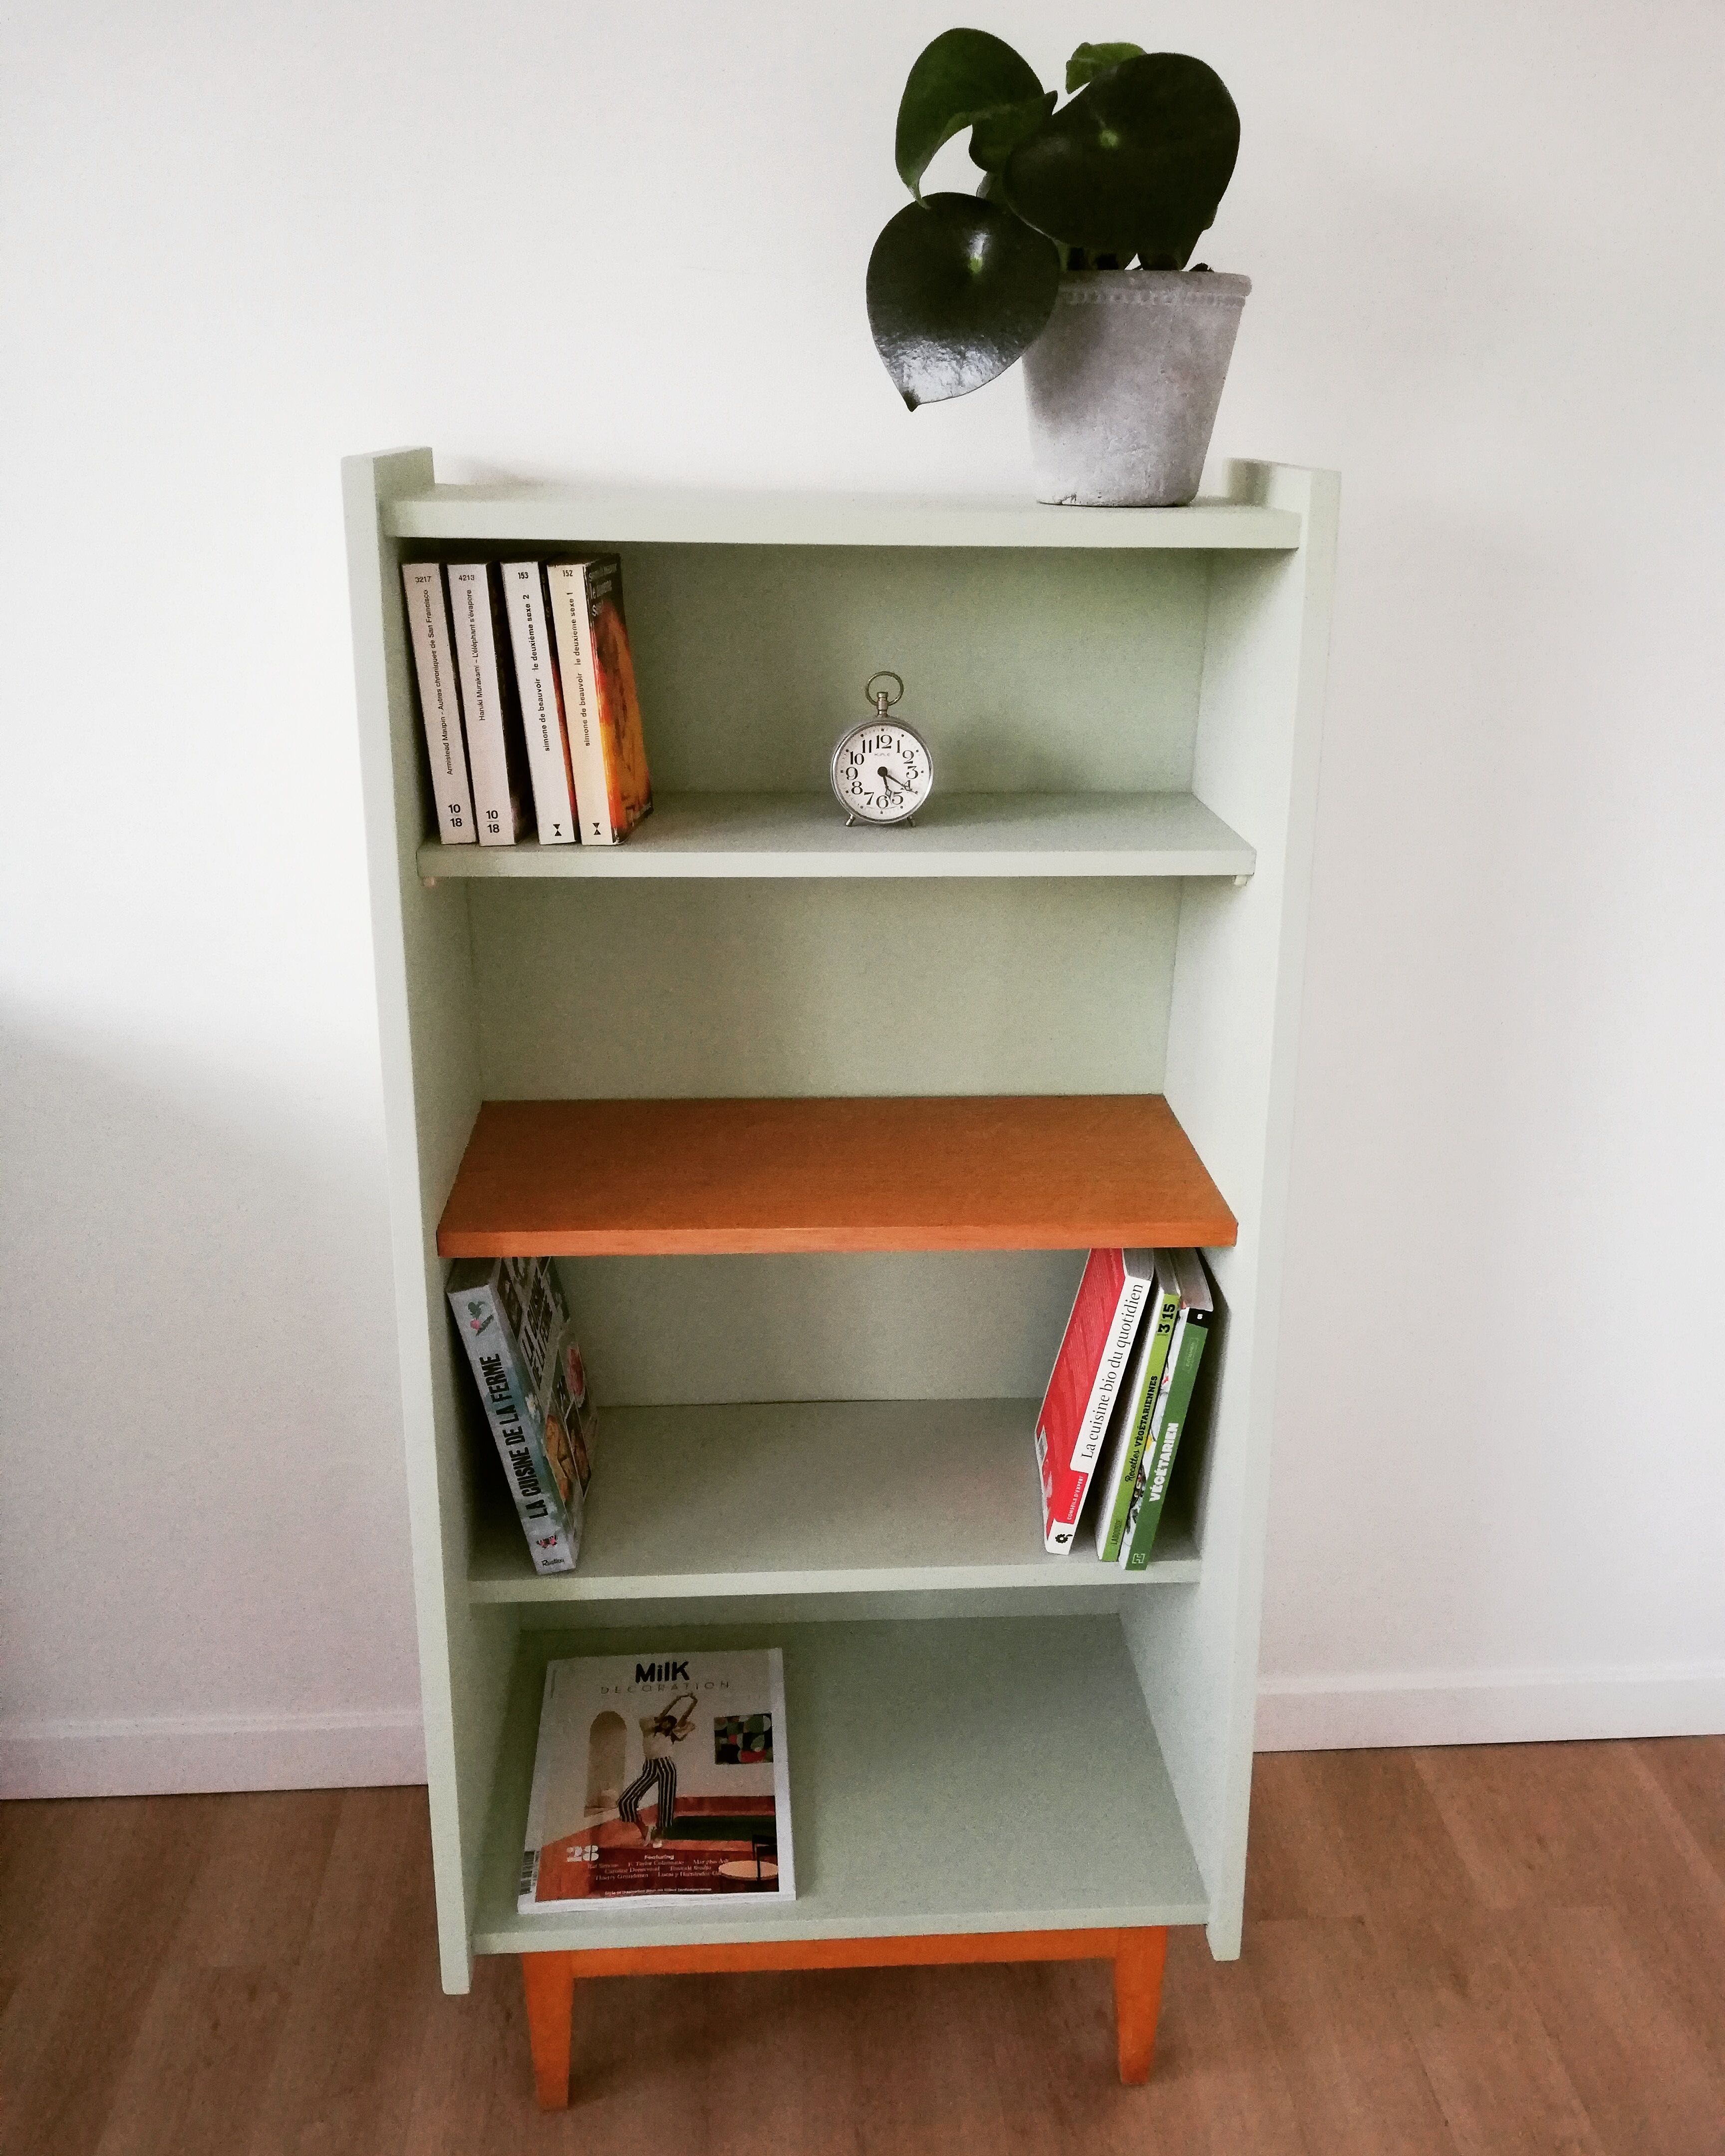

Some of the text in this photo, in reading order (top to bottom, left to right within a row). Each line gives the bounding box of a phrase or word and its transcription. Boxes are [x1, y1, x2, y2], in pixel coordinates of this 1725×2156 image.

[470, 624, 478, 658] L'éléphant
[431, 650, 441, 687] chroniques
[474, 665, 483, 698] Murakami
[535, 678, 545, 711] beauvoir
[576, 673, 585, 706] beauvoir
[477, 700, 486, 721] Haruki
[580, 708, 587, 717] de
[539, 714, 546, 723] de
[862, 740, 872, 754] 11
[876, 735, 892, 749] 12
[896, 740, 900, 753] 1
[443, 743, 453, 775] Armistead
[850, 751, 864, 765] 10
[902, 750, 914, 764] 2
[846, 767, 858, 780] 9
[906, 766, 918, 779] 3
[851, 781, 863, 795] 8
[863, 792, 874, 805] 7
[876, 795, 888, 808] 6
[891, 792, 903, 805] 5
[449, 804, 461, 813] 10
[486, 810, 498, 819] 10
[450, 818, 463, 827] 18
[488, 824, 500, 833] 18
[1081, 1284, 1143, 1459] La cuisine bio du quotidien
[480, 1353, 549, 1519] LA CUISINE DE LA FERME
[1125, 1449, 1140, 1482] Recettes
[1149, 1422, 1178, 1502] VÉGÉTARIEN
[1074, 1475, 1084, 1498] D'EXPERT
